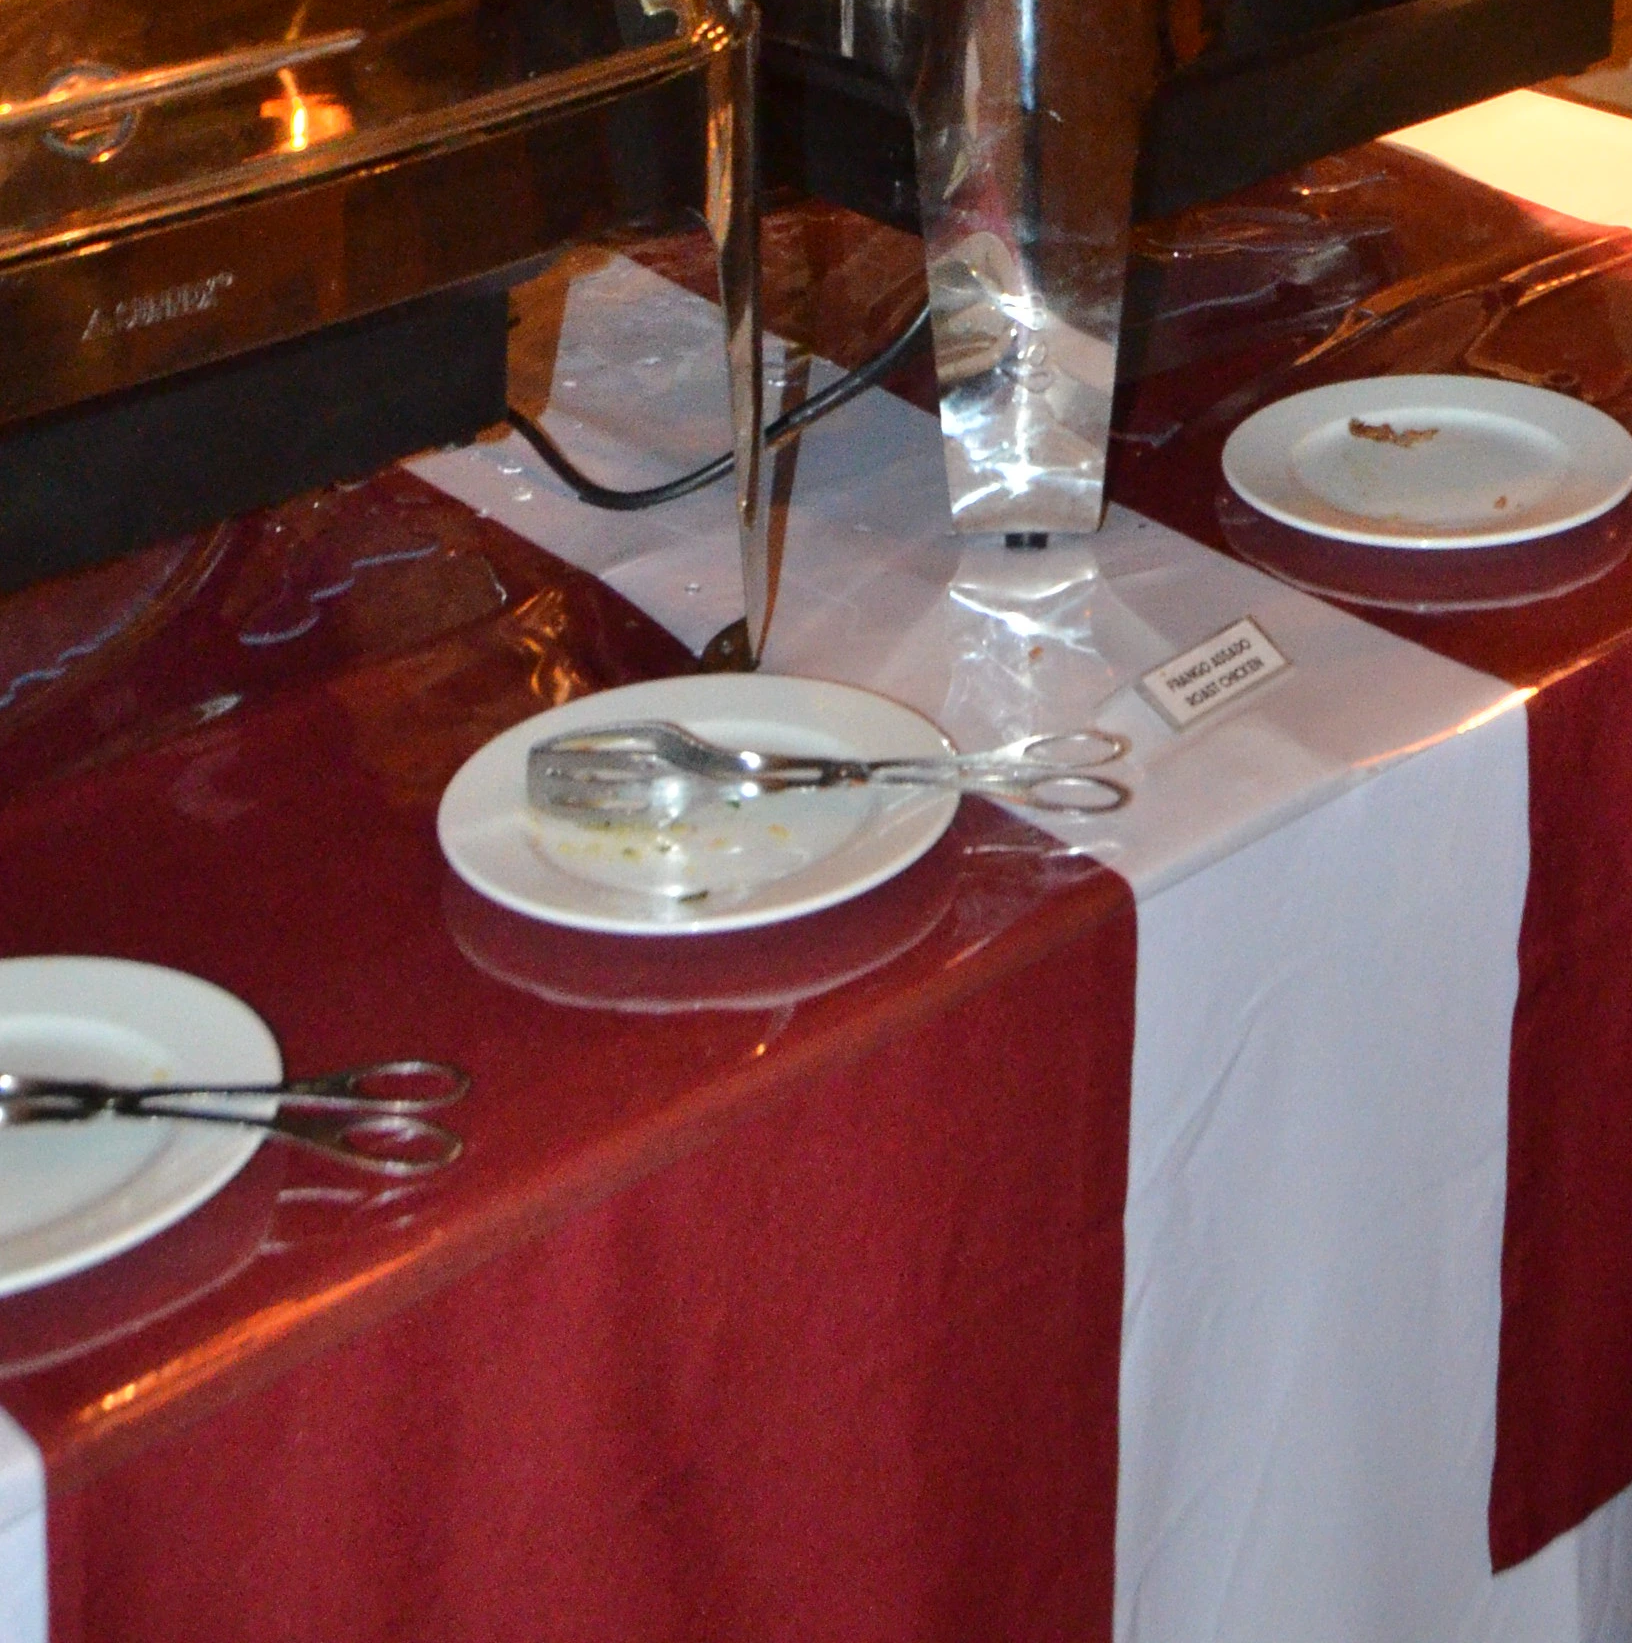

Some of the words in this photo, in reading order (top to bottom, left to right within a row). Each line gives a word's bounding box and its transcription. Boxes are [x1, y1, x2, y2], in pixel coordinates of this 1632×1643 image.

[1165, 660, 1212, 692] FRANGO
[1210, 637, 1252, 668] ASSADO
[1184, 680, 1221, 707] ROAST
[1218, 655, 1265, 689] CHICKEN
